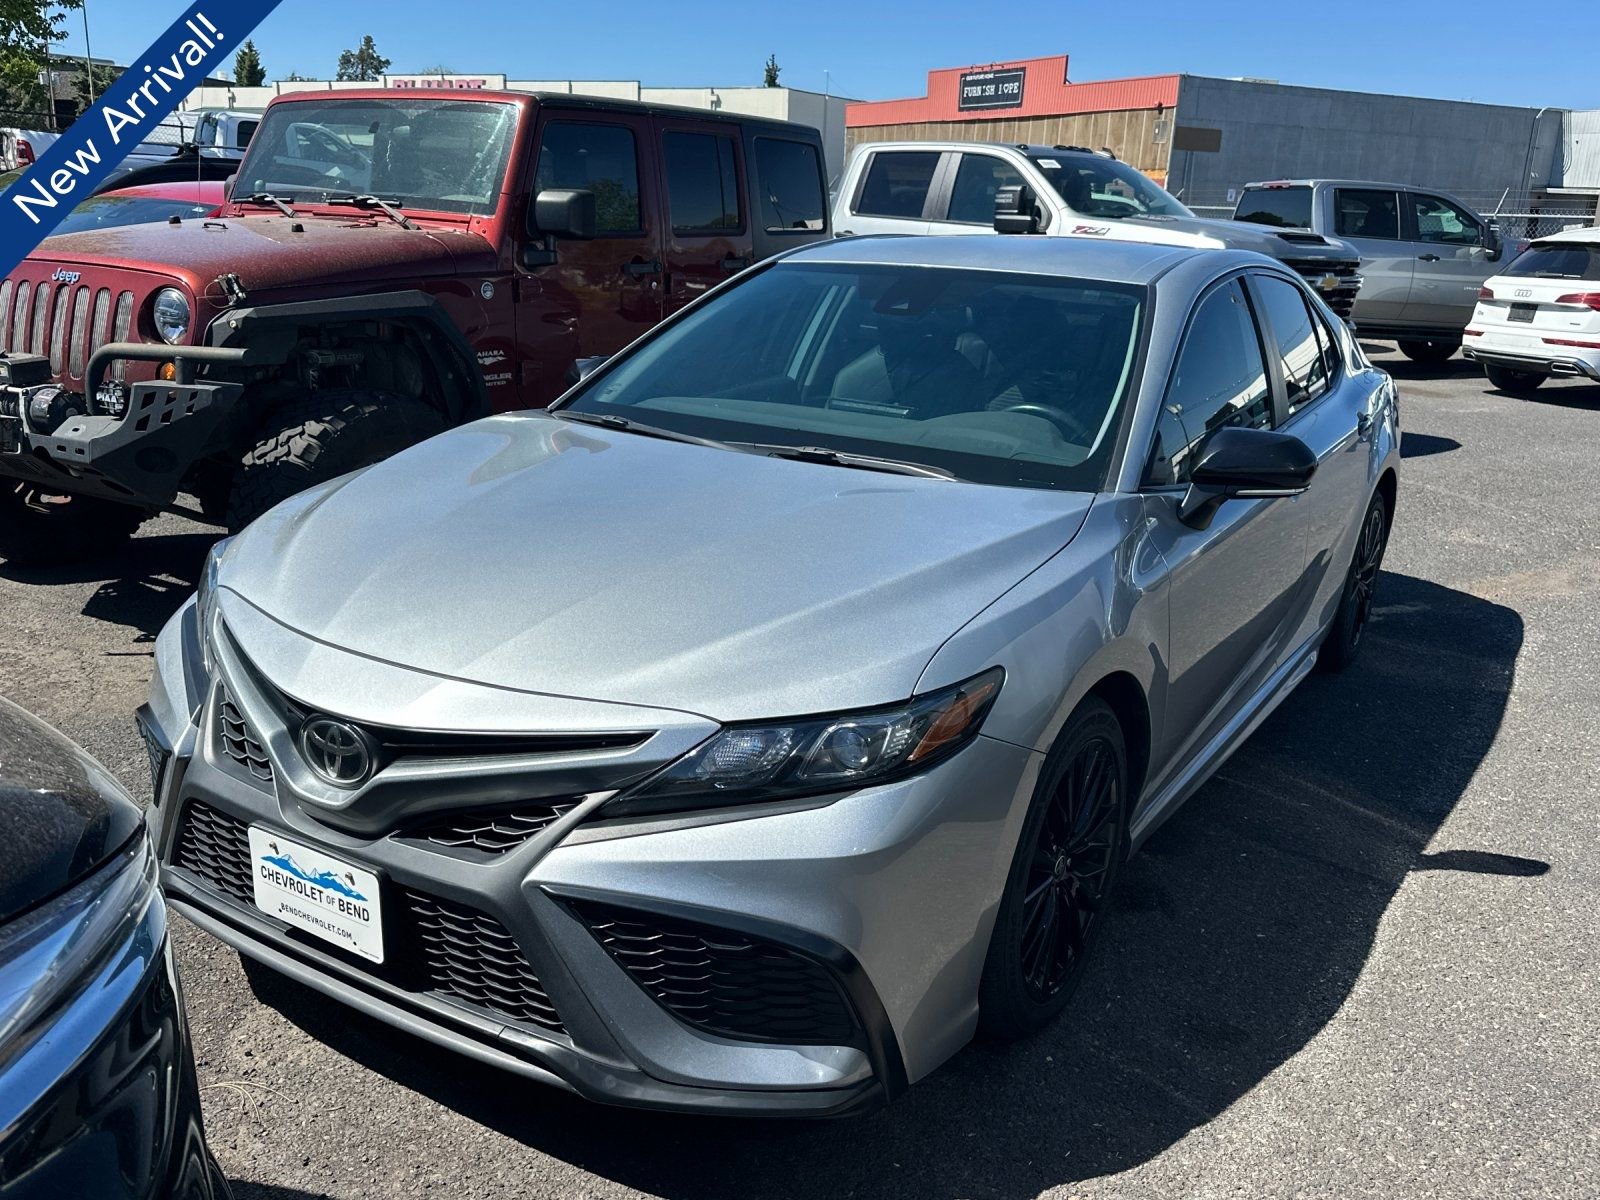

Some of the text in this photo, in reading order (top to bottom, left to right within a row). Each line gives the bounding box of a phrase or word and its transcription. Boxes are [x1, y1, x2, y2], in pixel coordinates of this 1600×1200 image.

[51, 266, 81, 285] Jeep
[483, 372, 512, 381] NGLER
[96, 390, 118, 404] PIAA
[260, 865, 370, 922] CHEVROLET OF BEND
[280, 902, 353, 940] BENDCHEVROLET.COM
